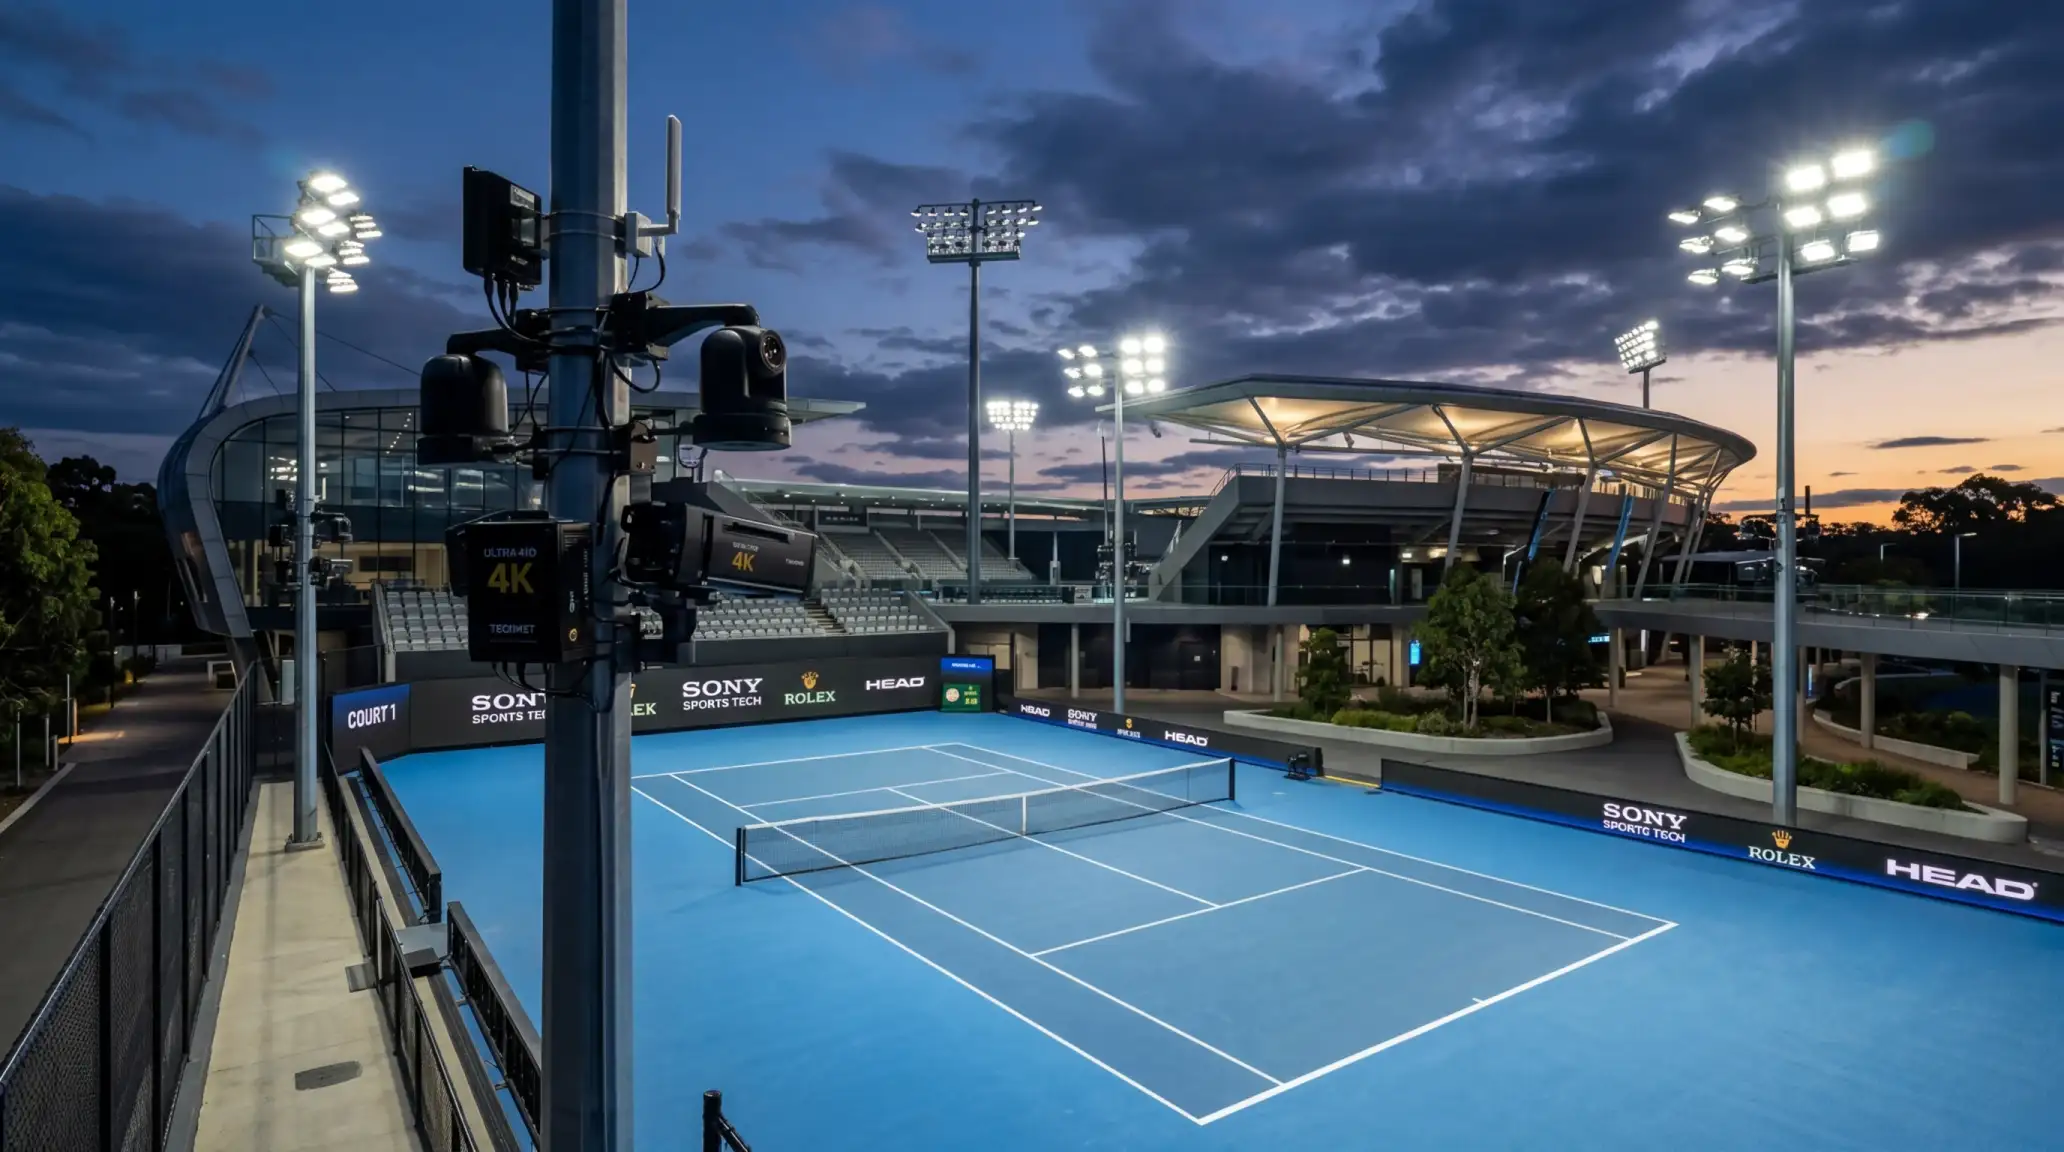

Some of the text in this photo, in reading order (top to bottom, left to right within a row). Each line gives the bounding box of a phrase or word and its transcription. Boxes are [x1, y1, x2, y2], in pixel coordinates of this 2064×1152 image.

[731, 551, 756, 572] 4K
[487, 562, 534, 593] 4K
[682, 678, 763, 697] SONY
[866, 677, 925, 691] HEAD
[683, 696, 762, 711] SPORTS TECH
[784, 690, 836, 705] ROLEX
[347, 703, 396, 729] COURT 1
[1067, 708, 1098, 722] SONY
[1603, 803, 1687, 830] SONY
[1748, 845, 1816, 870] ROLEX
[1886, 858, 2035, 901] HEAD
